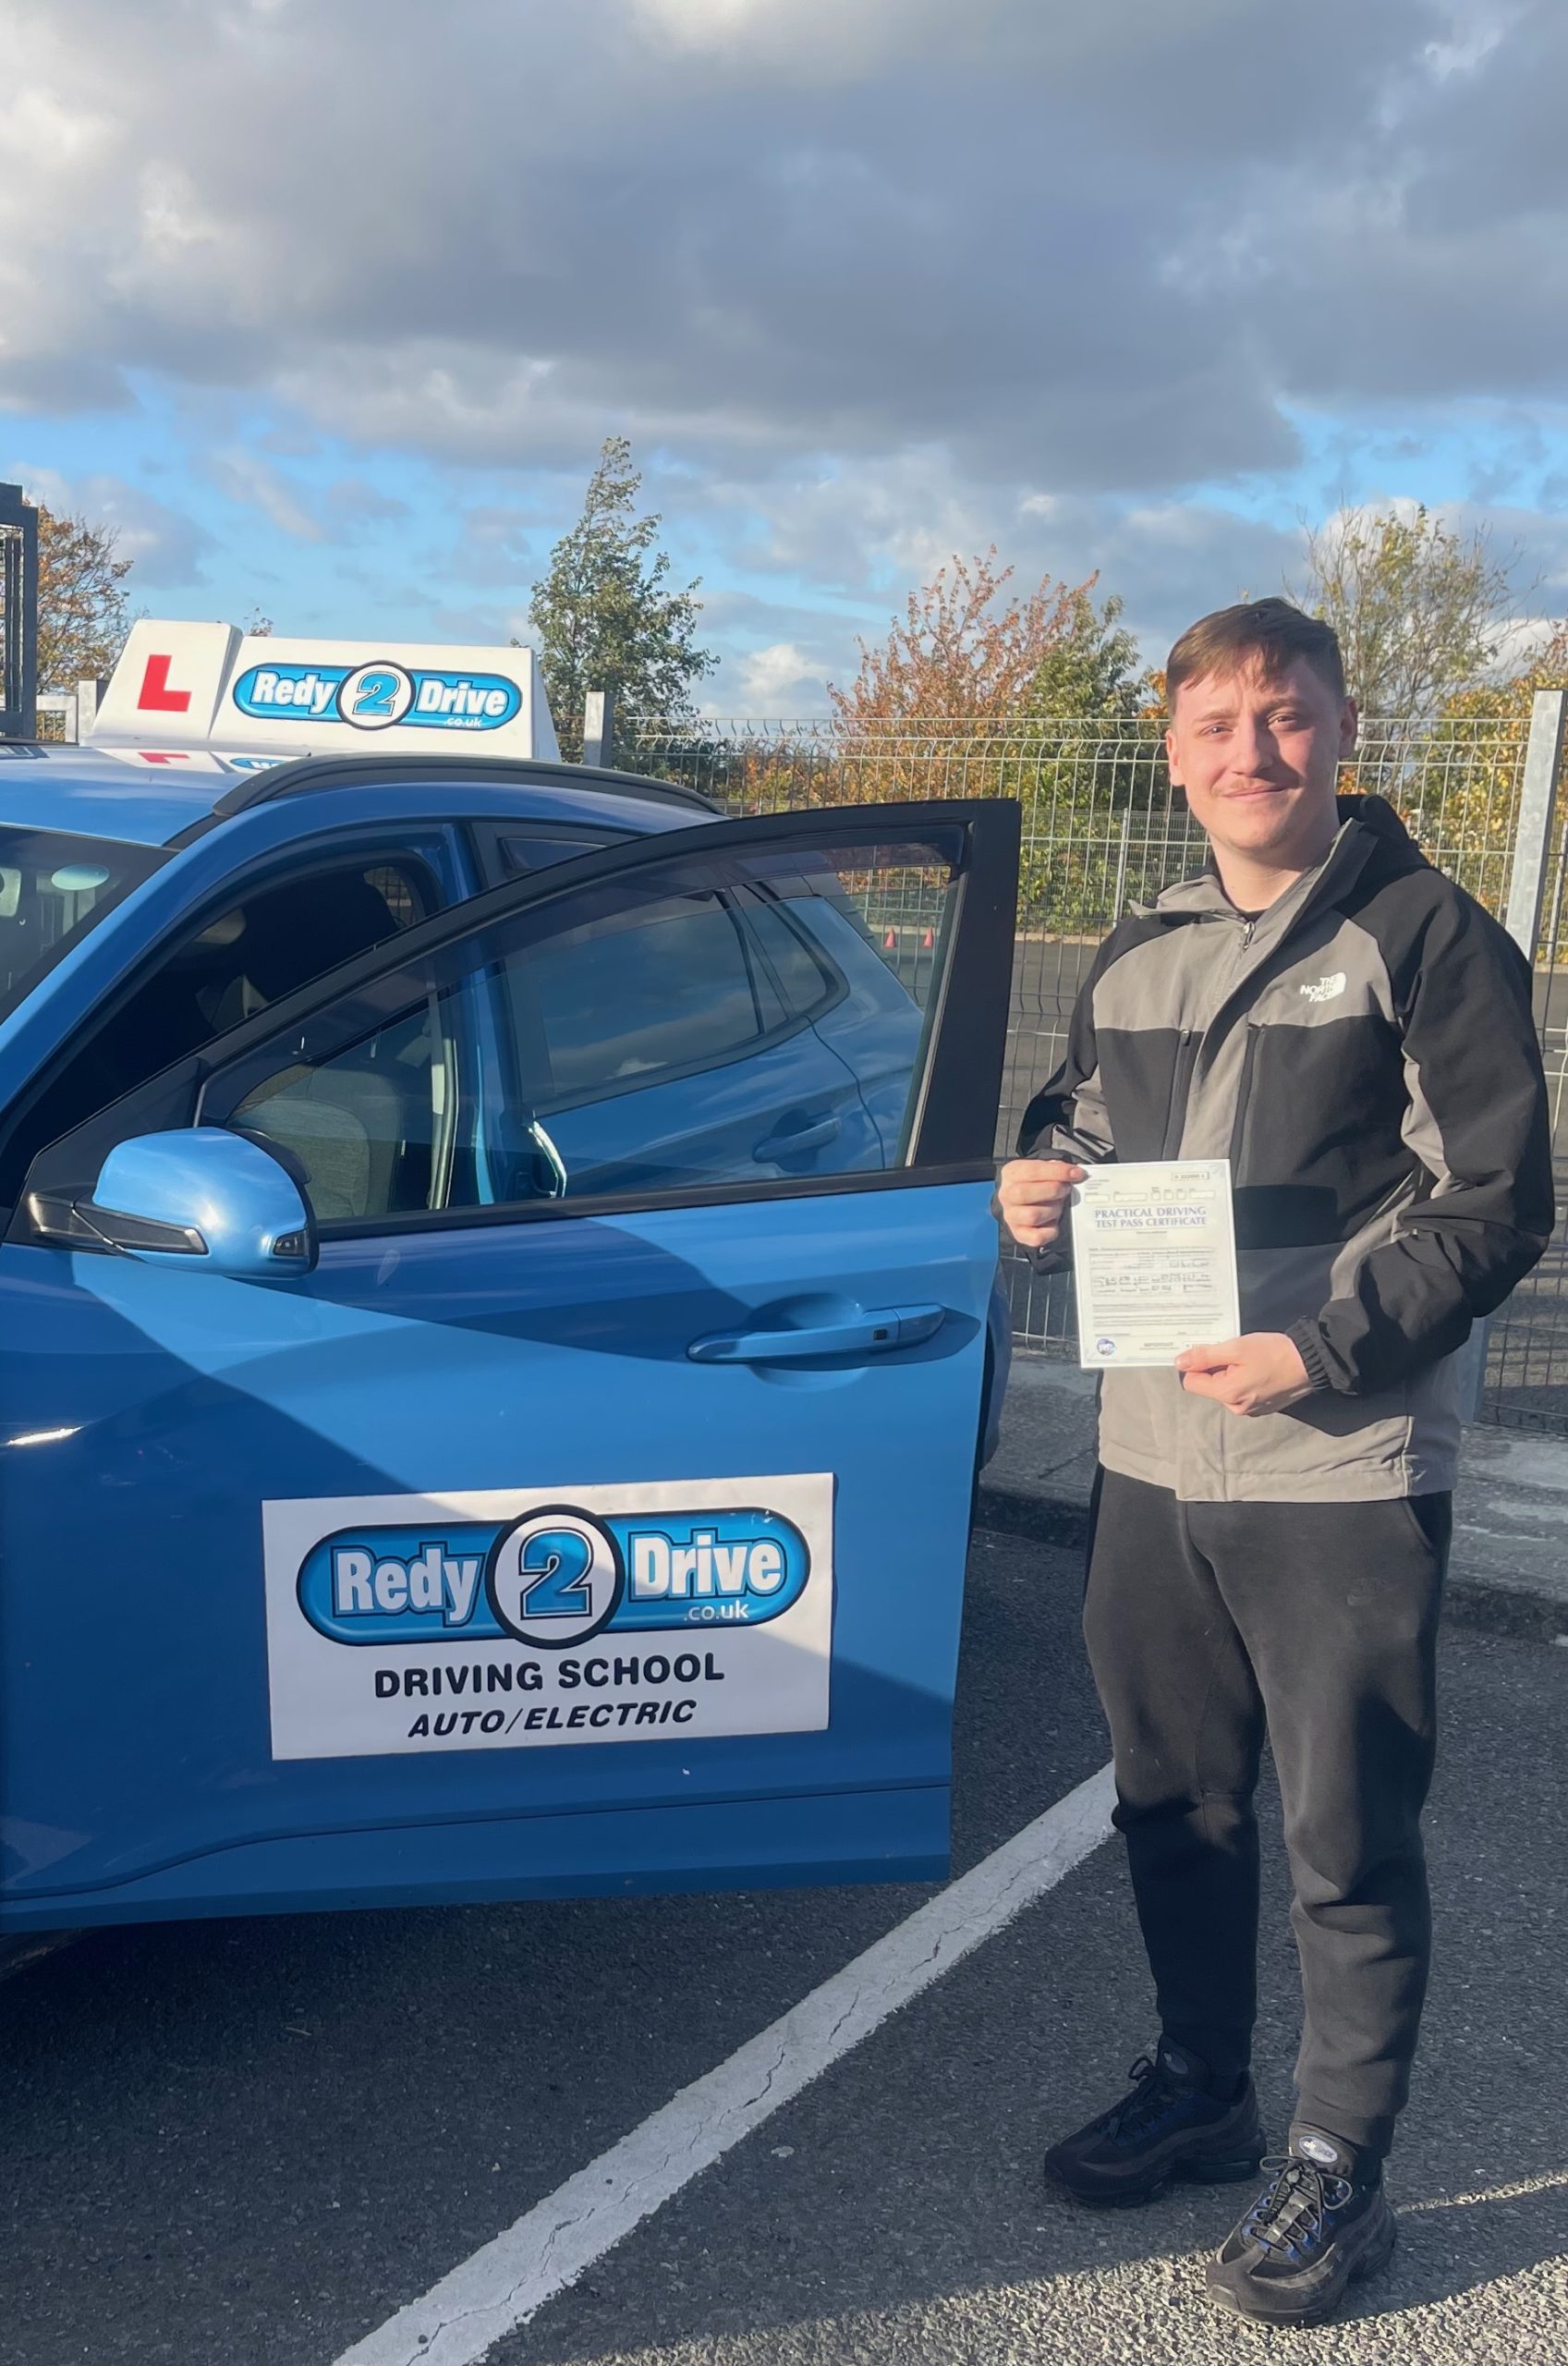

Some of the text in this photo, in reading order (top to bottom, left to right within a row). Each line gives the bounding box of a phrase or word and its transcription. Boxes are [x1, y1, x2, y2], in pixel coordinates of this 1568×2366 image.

[137, 654, 191, 712] L
[252, 671, 508, 716] Redy 2 Drive
[444, 716, 482, 727] .co.uk
[1095, 1206, 1207, 1218] PRACTICAL DRIVING
[1097, 1216, 1207, 1227] TEST PASS CERTIFICATE
[335, 1528, 783, 1624] Redy 2 Drive
[684, 1601, 749, 1621] .co.uk
[375, 1653, 725, 1698] DRIVING SCHOOL
[407, 1700, 697, 1738] AUTO/ELECTRIC
